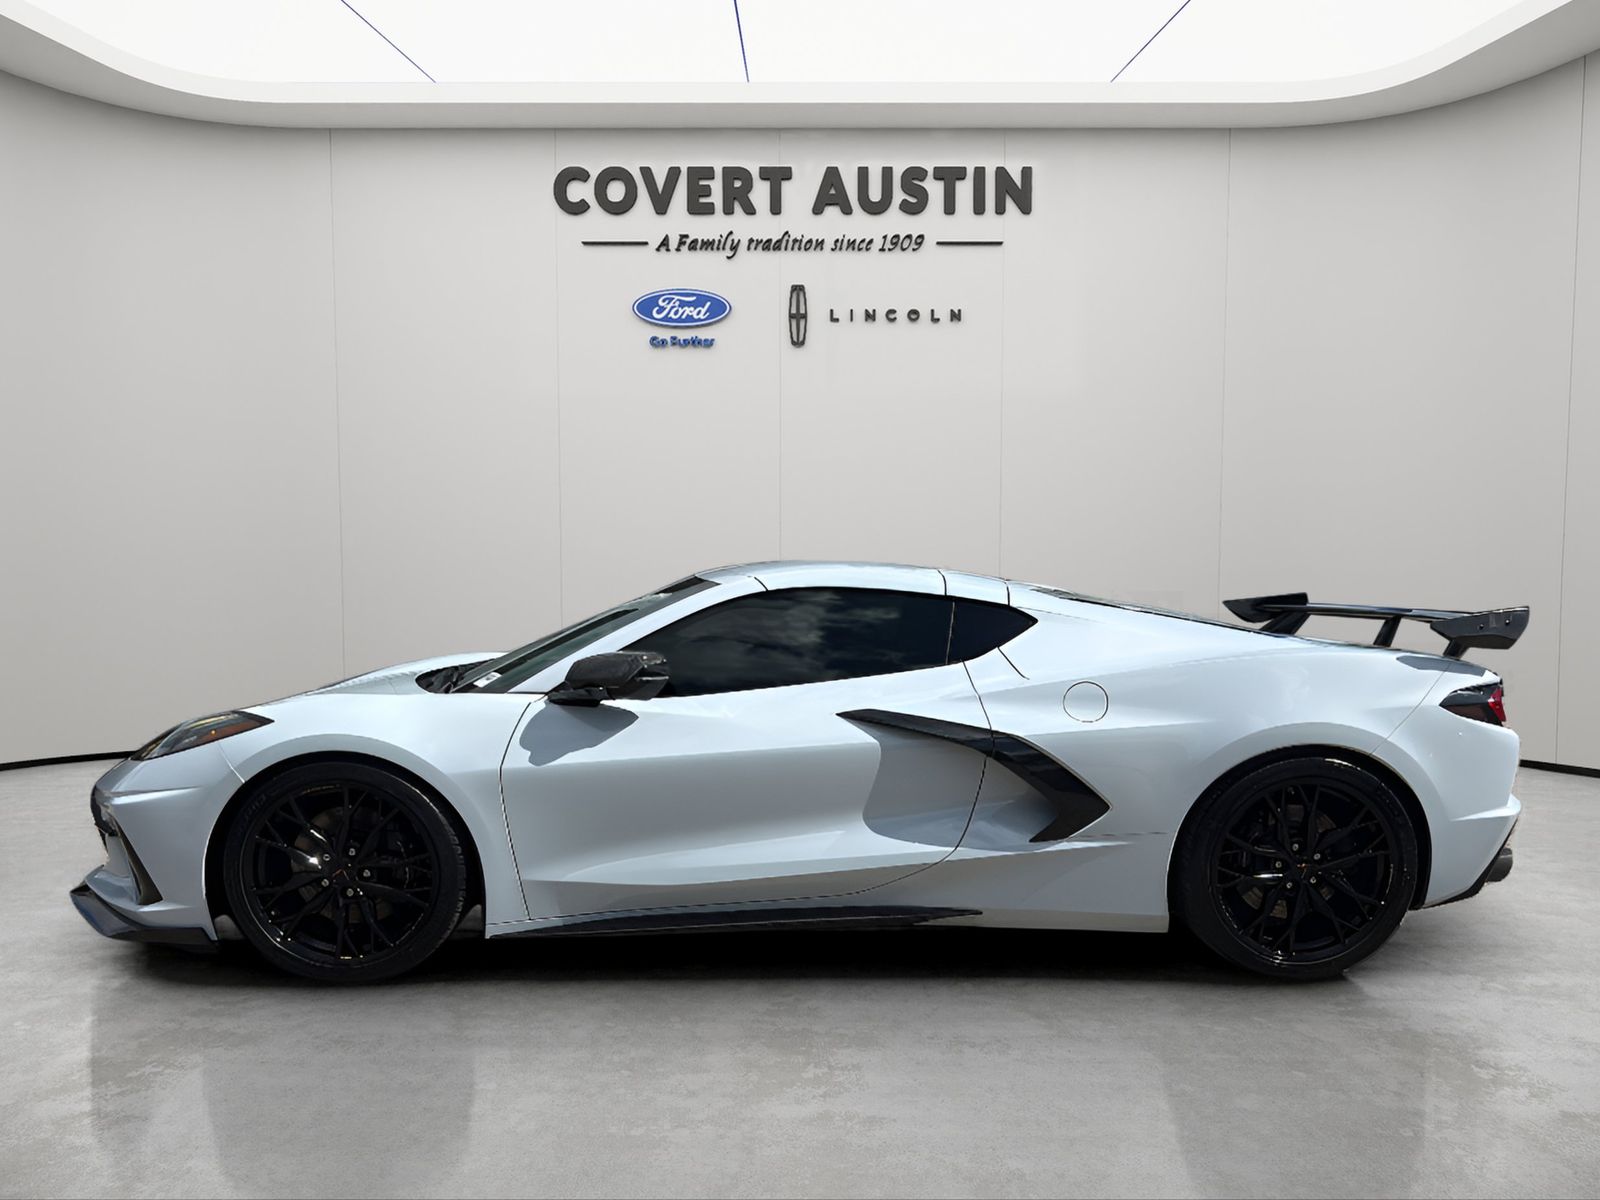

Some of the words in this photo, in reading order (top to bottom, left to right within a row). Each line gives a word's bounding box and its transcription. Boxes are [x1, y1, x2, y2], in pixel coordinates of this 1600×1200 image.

[553, 166, 792, 216] COVERT
[812, 166, 1033, 216] AUSTIN
[655, 233, 671, 253] A
[674, 230, 741, 260] Family
[746, 230, 825, 252] tradition
[830, 237, 874, 252] since
[878, 233, 925, 253] 1909
[652, 294, 711, 320] Ford
[829, 308, 962, 324] LINCOLN
